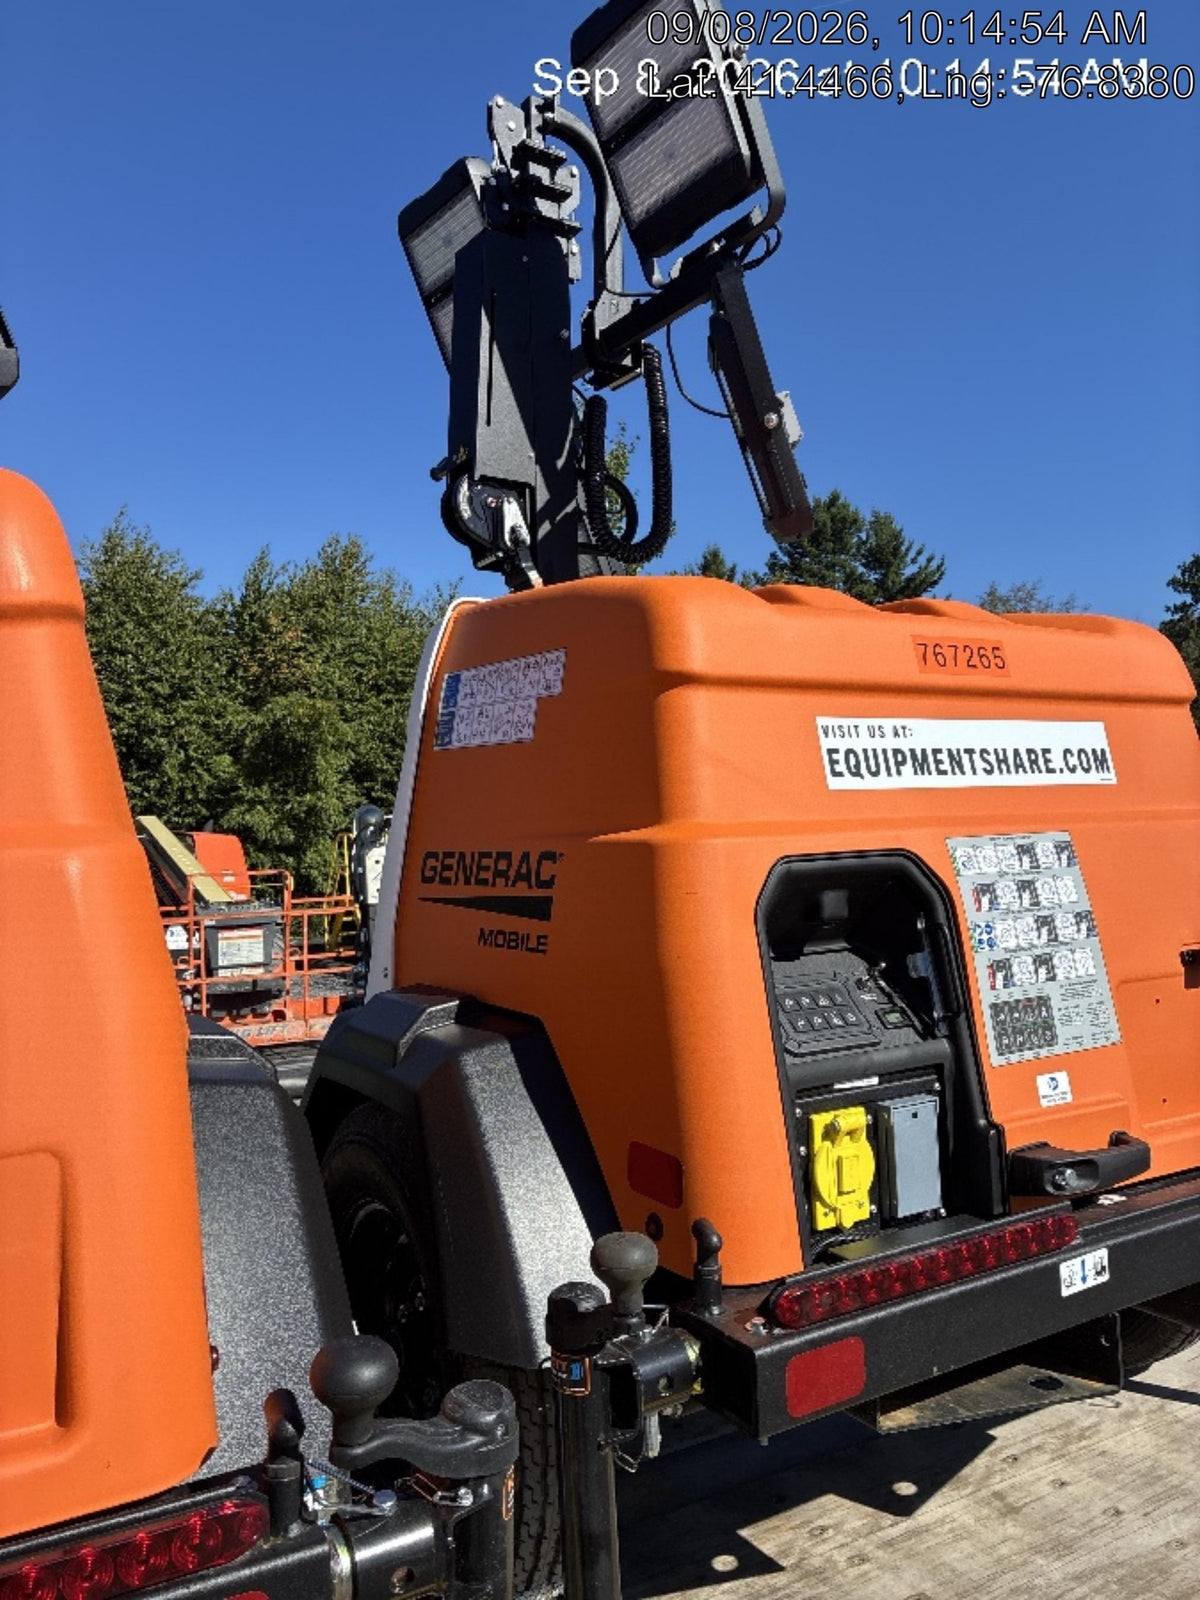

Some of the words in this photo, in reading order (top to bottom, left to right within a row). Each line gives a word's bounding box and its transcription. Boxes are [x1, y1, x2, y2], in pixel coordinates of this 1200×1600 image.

[915, 642, 1006, 670] 767265
[821, 724, 861, 739] VISIT
[867, 724, 886, 739] US
[892, 724, 914, 739] AT:
[826, 747, 1112, 780] EQUIPMENTSHARE.COM
[420, 850, 558, 890] GENERAC
[477, 927, 549, 955] MOBILE
